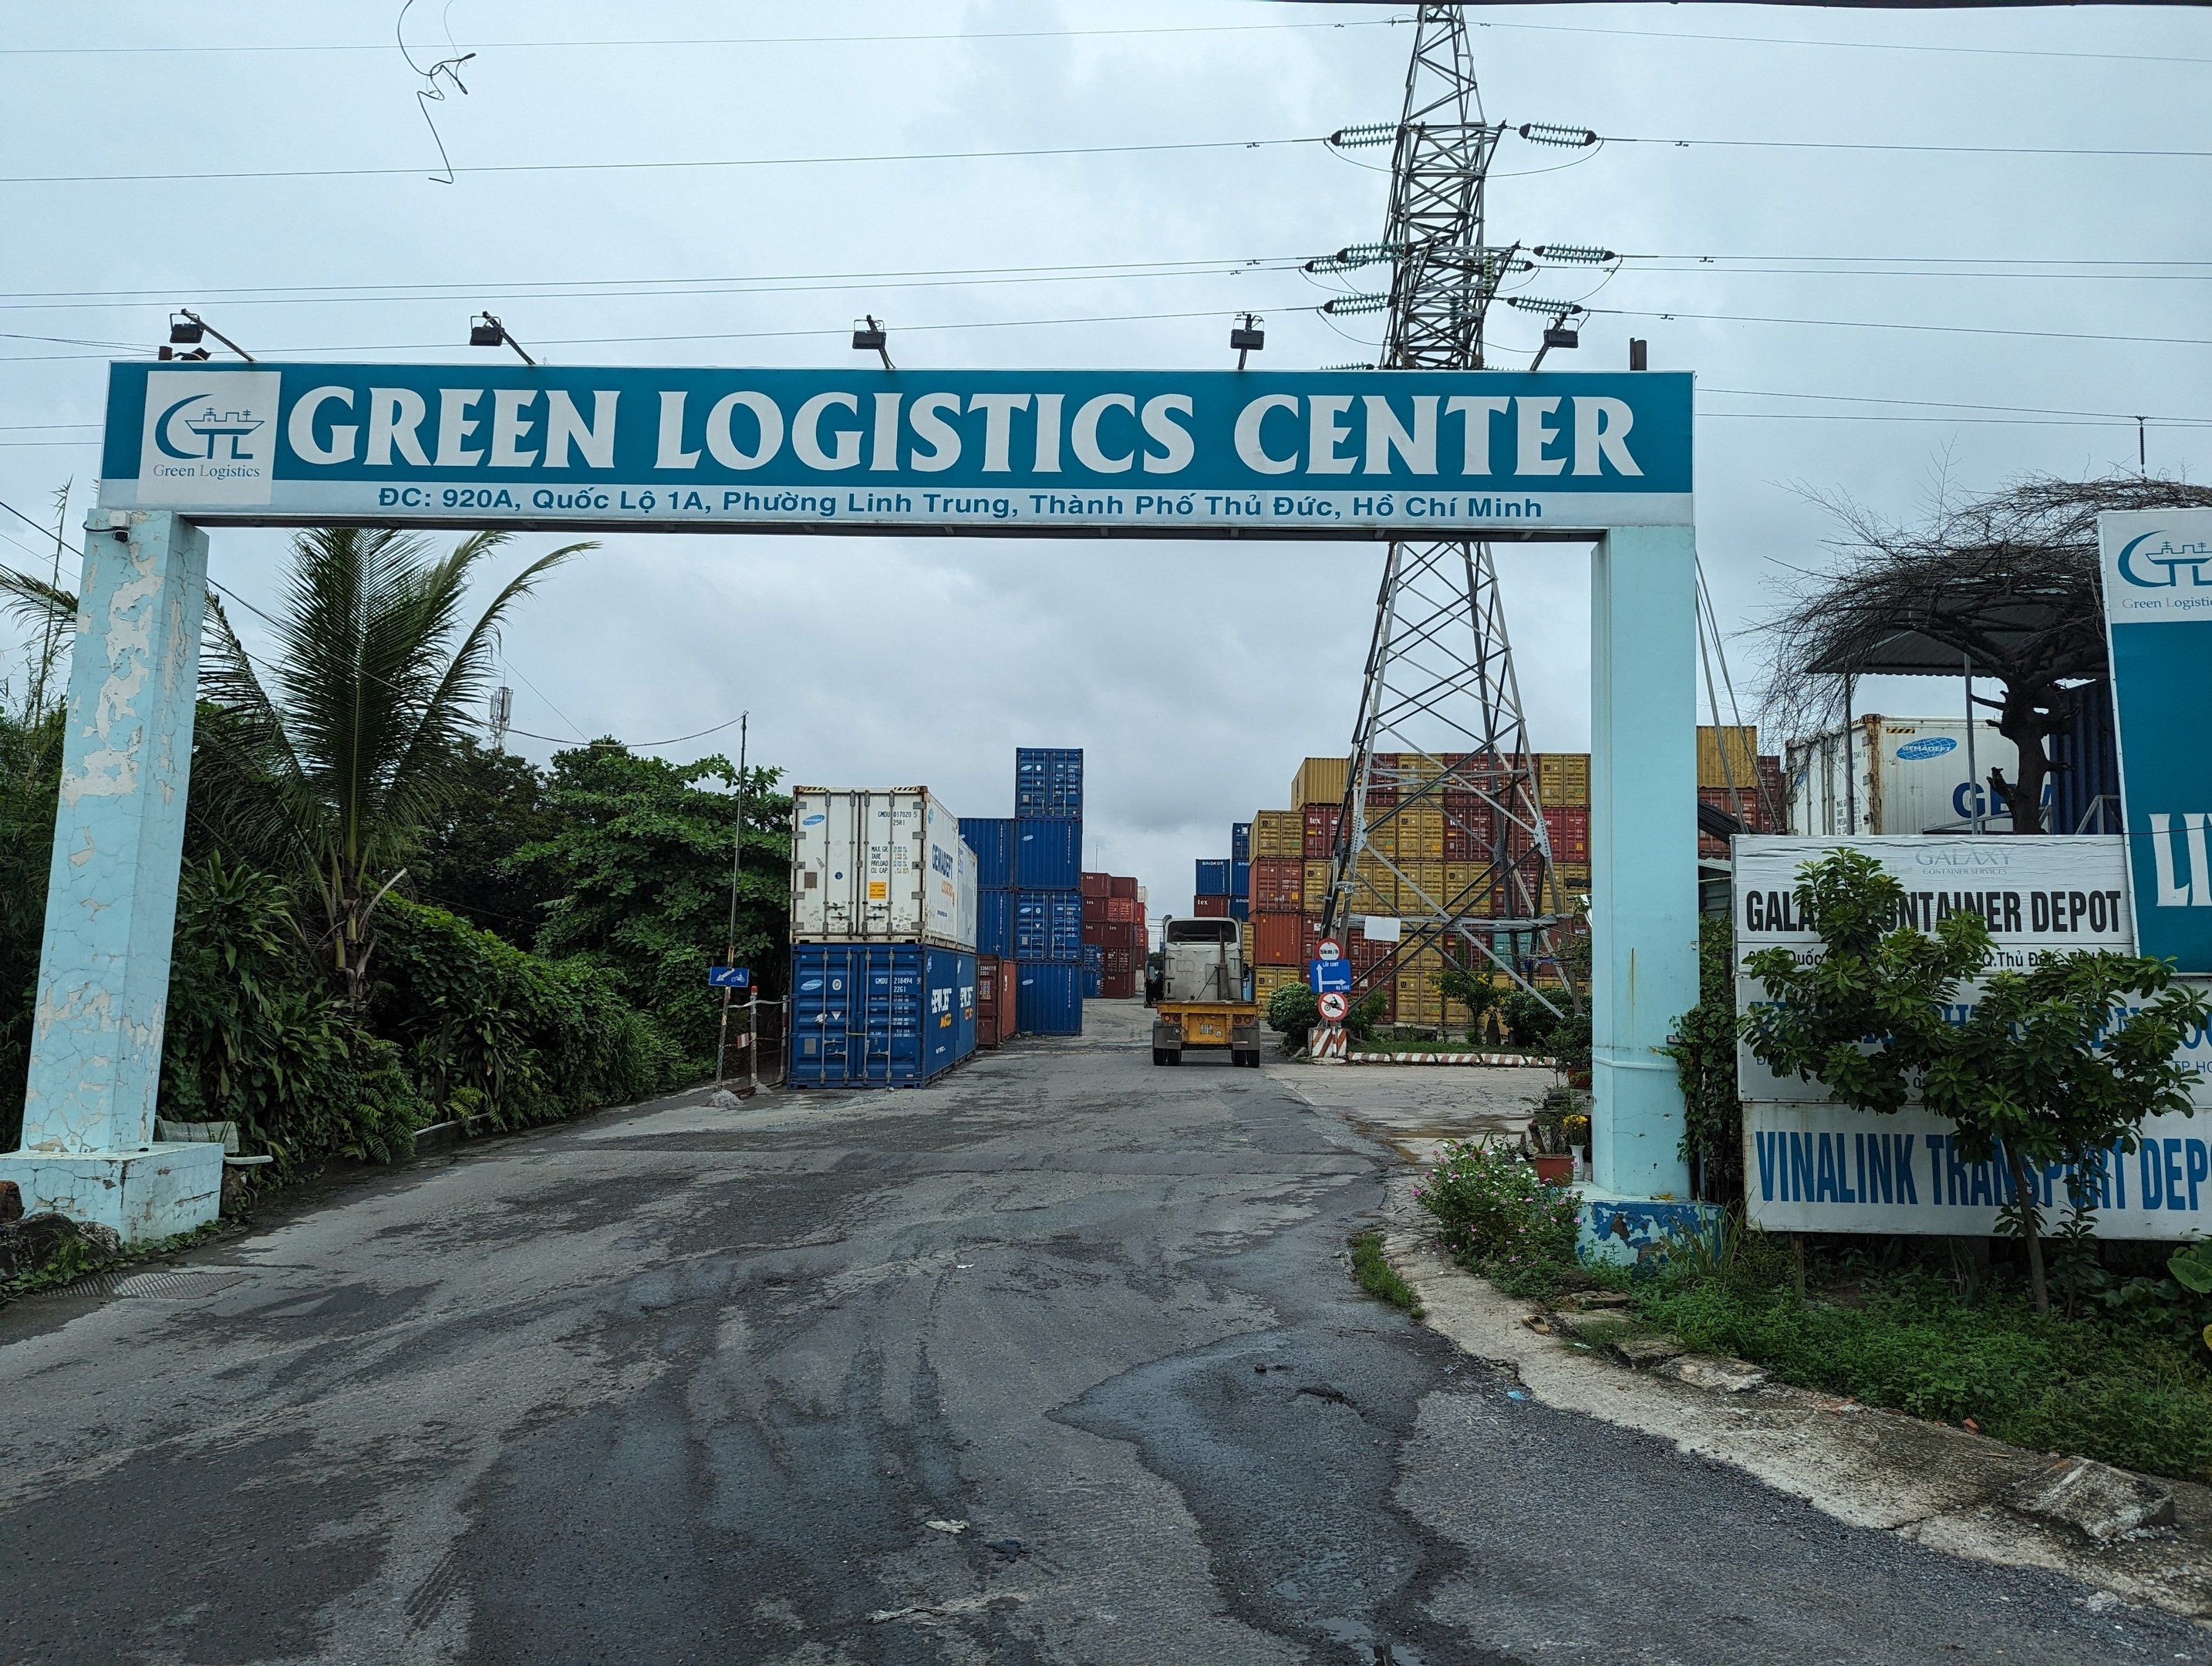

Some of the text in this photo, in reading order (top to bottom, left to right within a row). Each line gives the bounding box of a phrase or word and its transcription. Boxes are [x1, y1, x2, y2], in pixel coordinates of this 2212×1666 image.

[288, 386, 1644, 476] GREEN LOGISTICS CENTER
[153, 464, 260, 480] Green Logistics
[379, 487, 1542, 520] ĐC: 920A, Quốc Lộ 1A, Phường Linh Trung, Thành Phố Thủ Đức, Hồ Chí Minh
[2122, 598, 2162, 609] Green
[1310, 816, 1321, 825] tex
[1916, 848, 2013, 866] GALAXY
[2149, 813, 2212, 907] LI
[1746, 890, 2121, 932] GALA ONTAINER DEPOT
[1756, 1131, 1918, 1206] VINALINK
[2140, 1138, 2212, 1211] DEP
